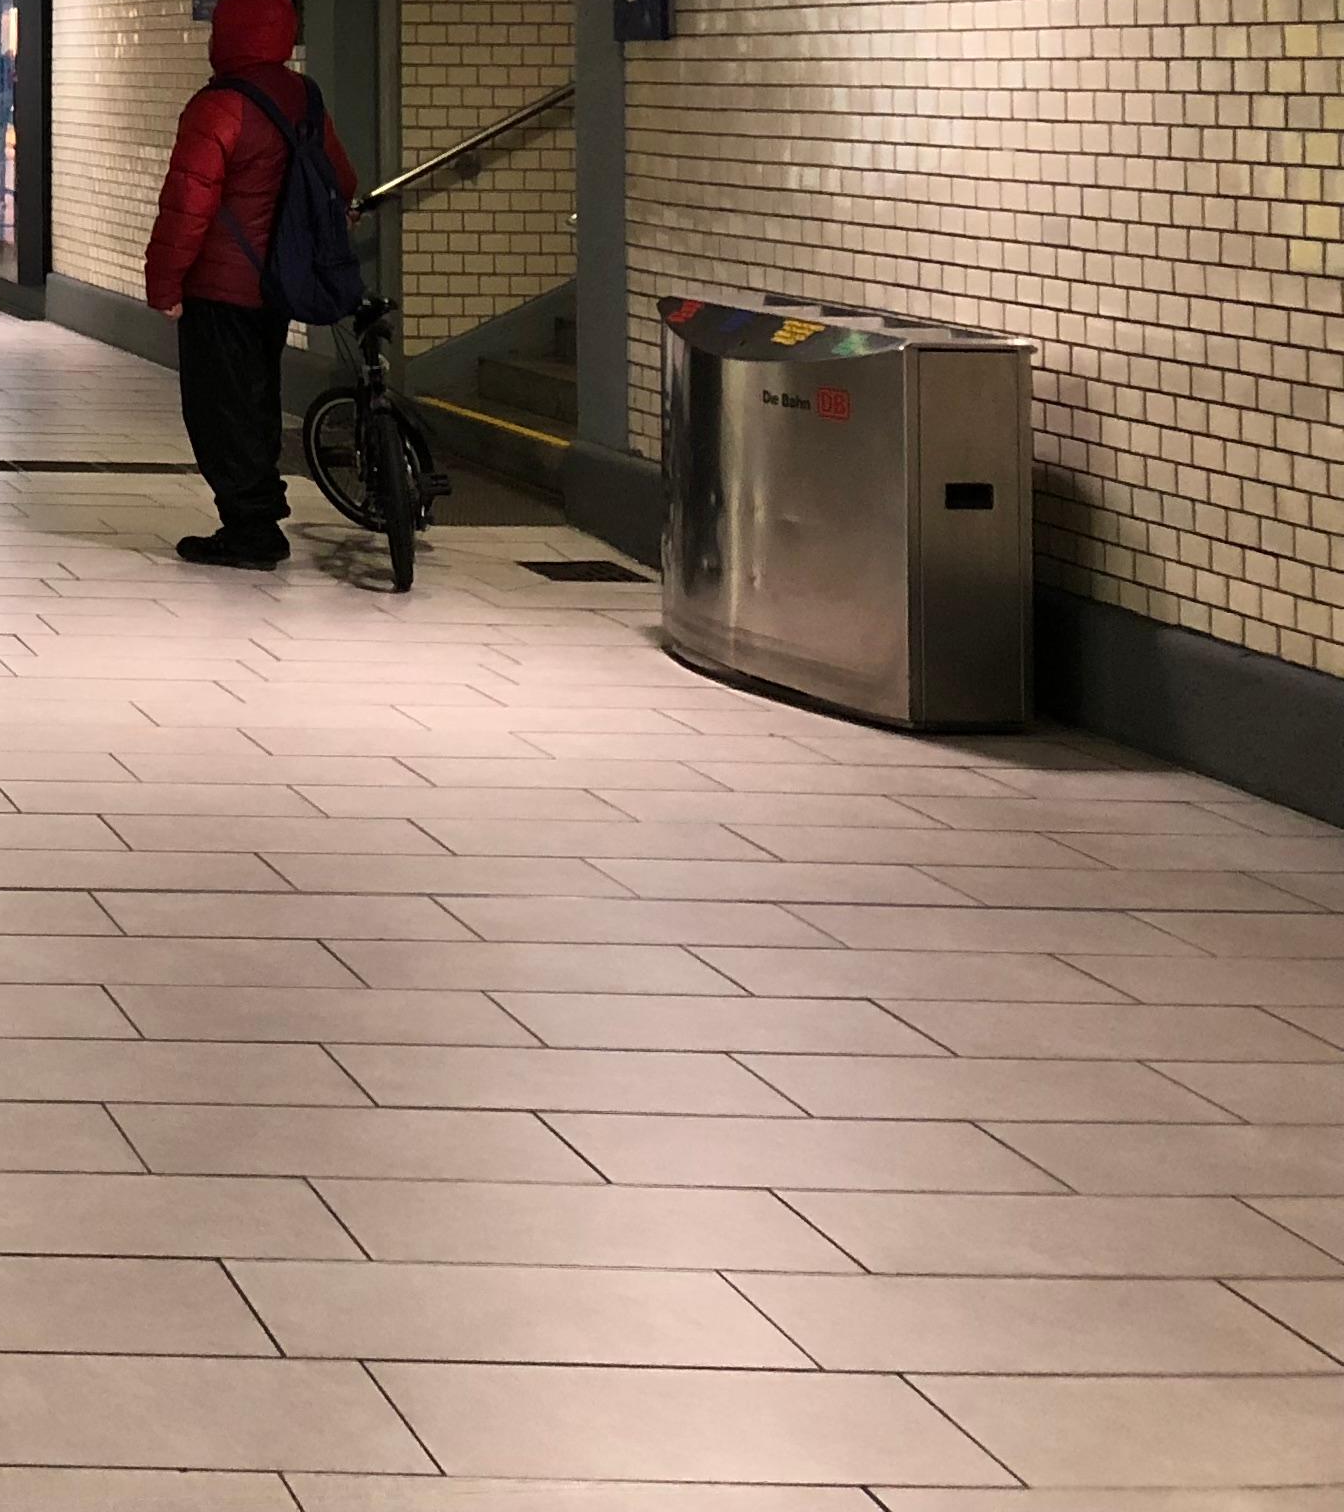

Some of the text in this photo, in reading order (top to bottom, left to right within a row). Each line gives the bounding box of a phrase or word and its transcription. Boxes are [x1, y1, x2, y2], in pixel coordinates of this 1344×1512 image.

[762, 389, 849, 418] Die Bahn DB
